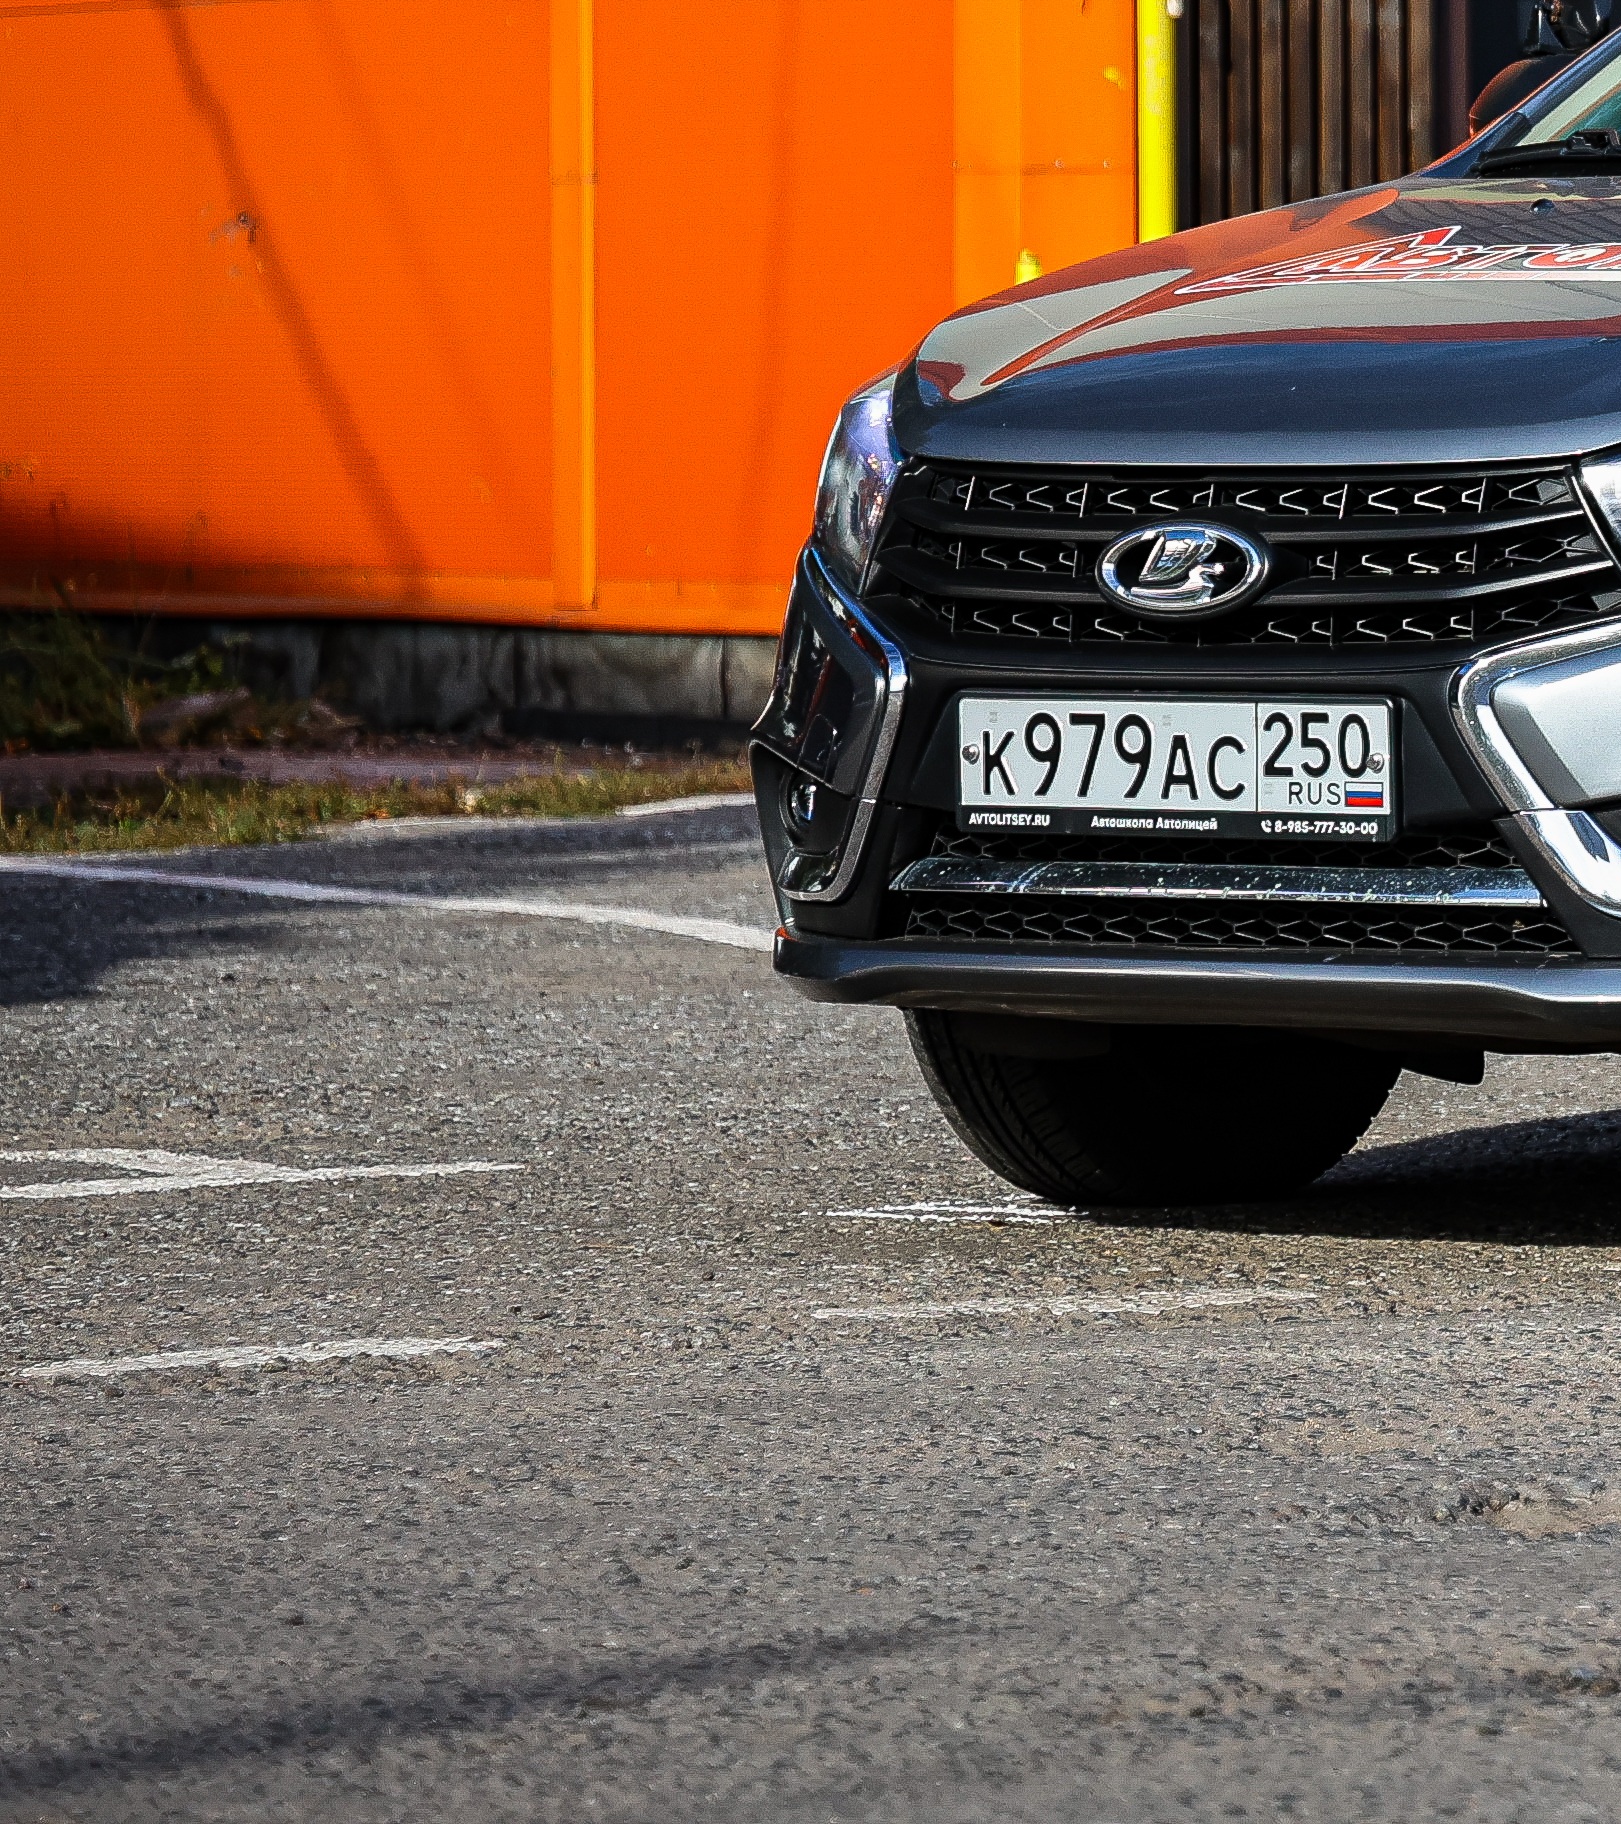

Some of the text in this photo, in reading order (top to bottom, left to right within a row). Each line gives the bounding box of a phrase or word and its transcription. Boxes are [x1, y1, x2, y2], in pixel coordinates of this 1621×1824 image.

[1262, 712, 1372, 778] 250
[1287, 782, 1342, 806] RUS
[969, 813, 1050, 827] AVTOLITSEY.RU
[1091, 816, 1218, 832] Автошкола Автолицей
[1274, 820, 1379, 836] 8-985-777-30-00
